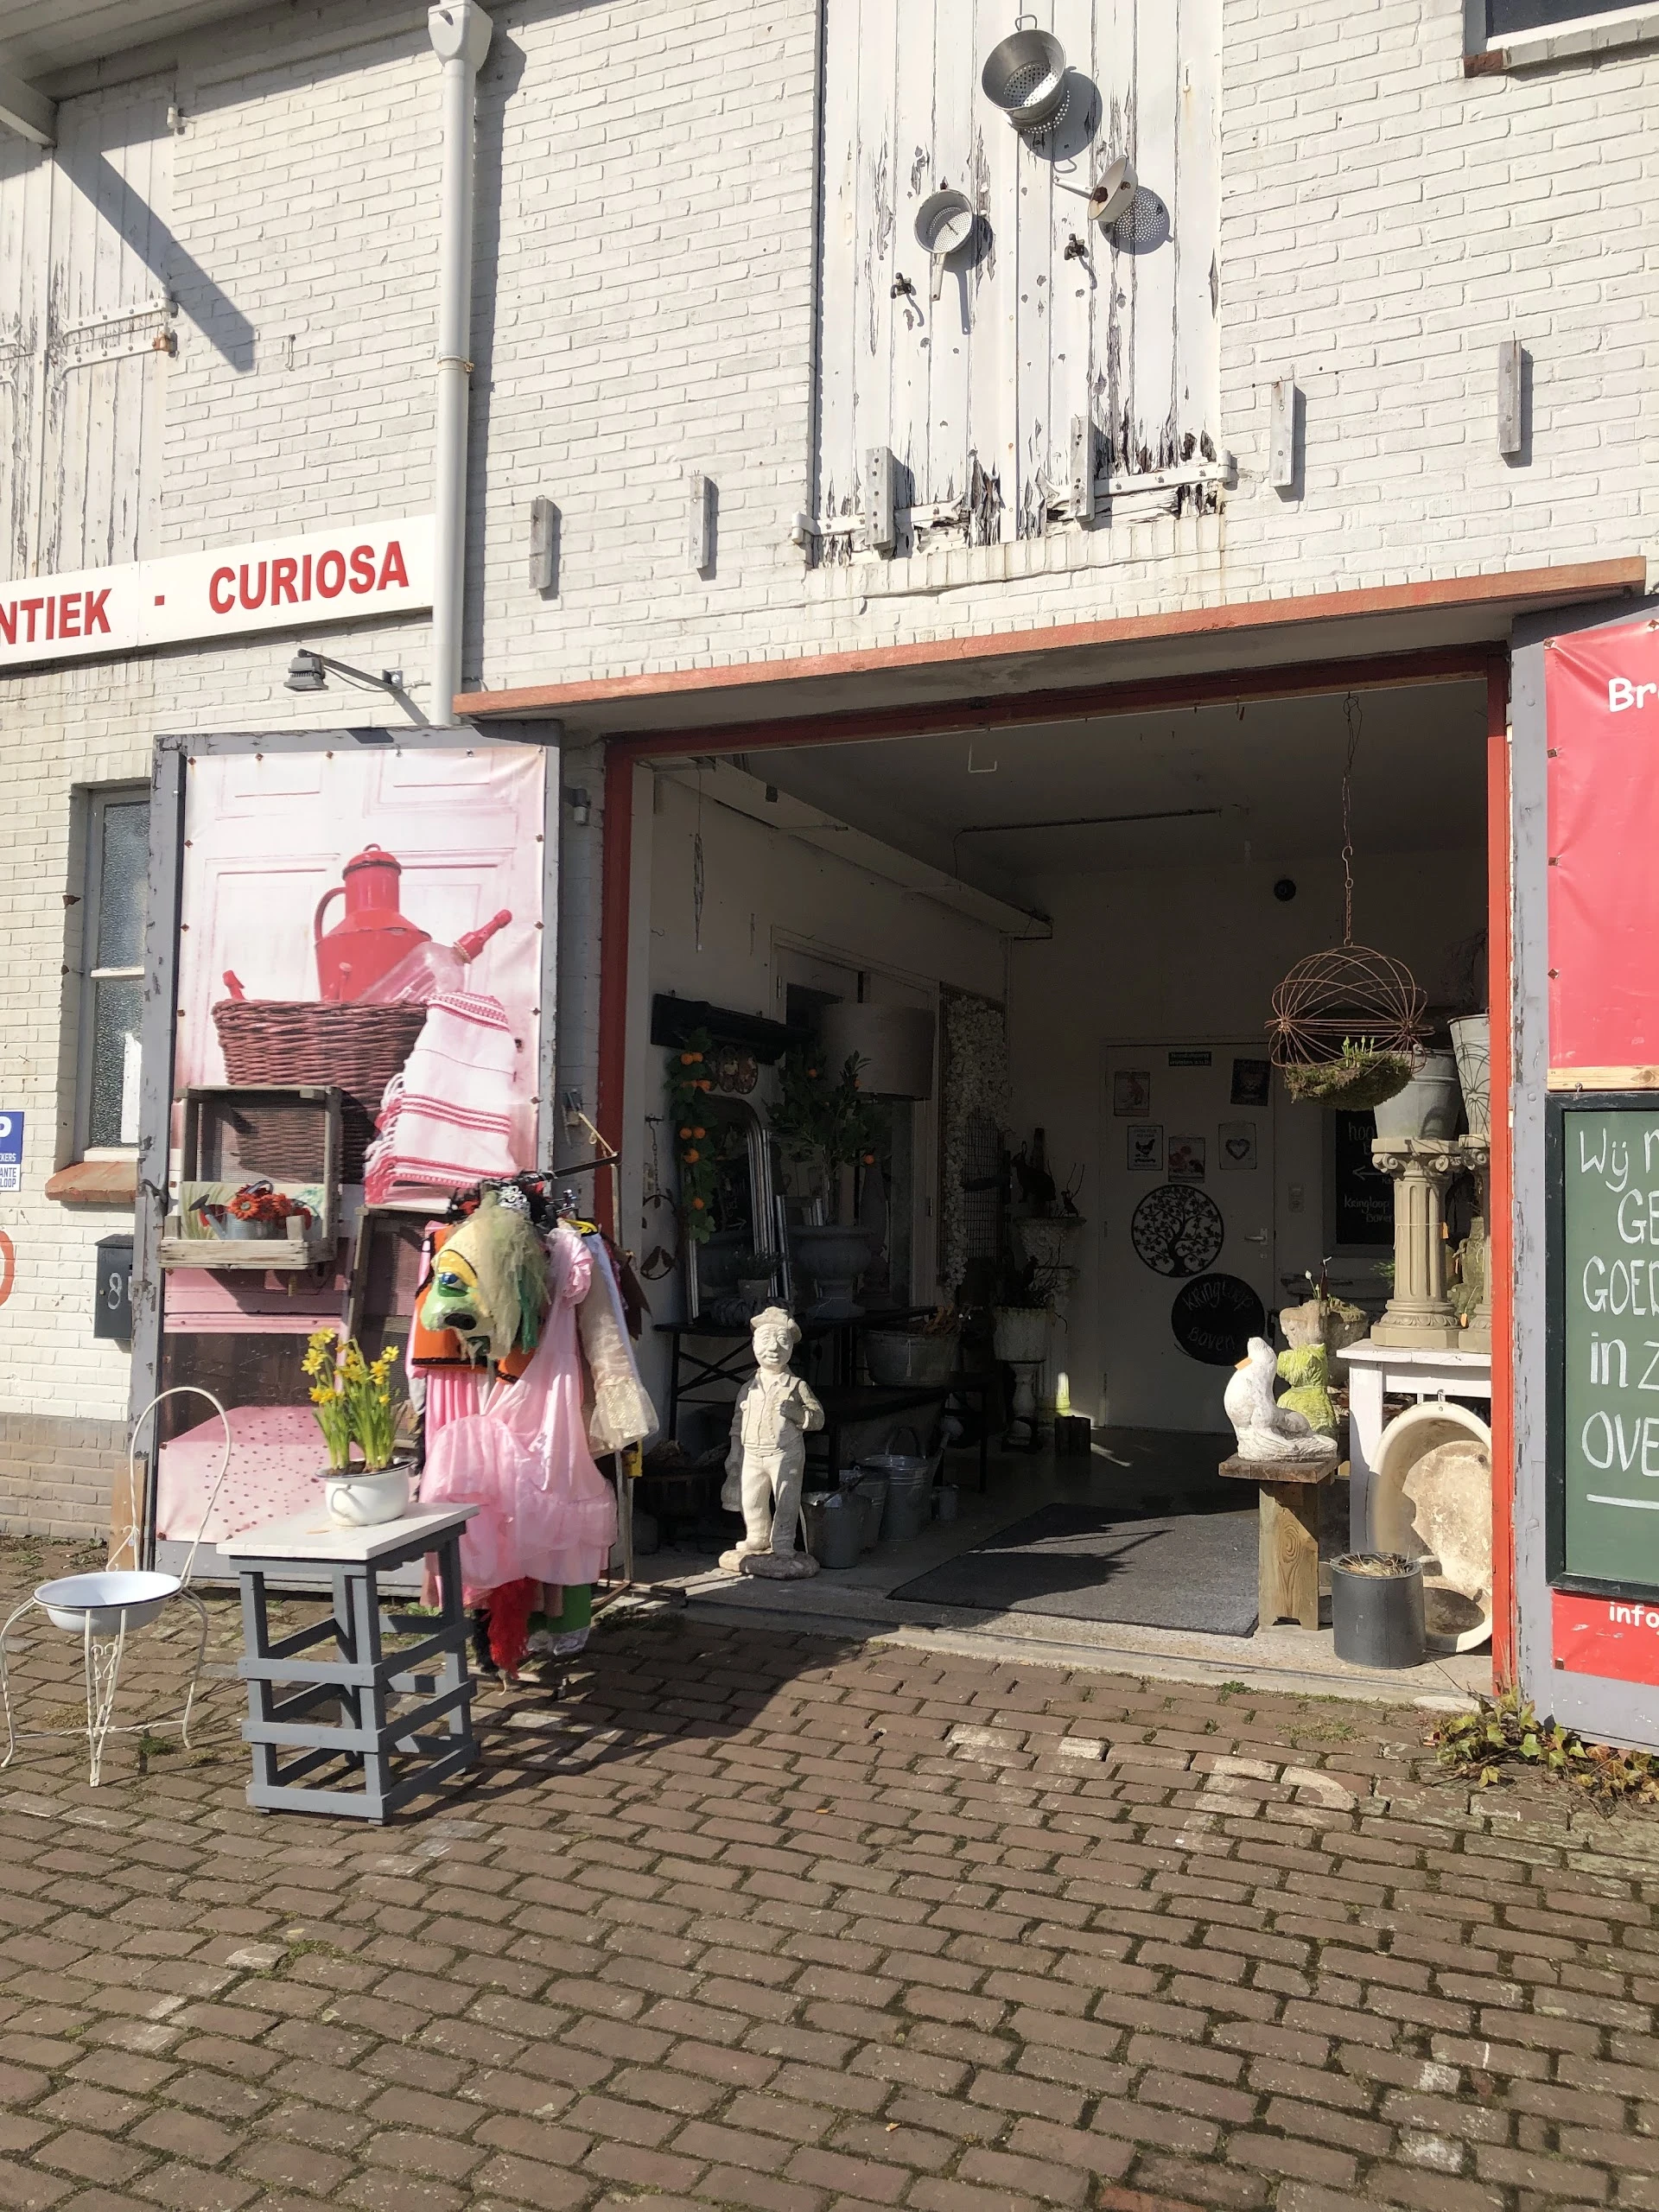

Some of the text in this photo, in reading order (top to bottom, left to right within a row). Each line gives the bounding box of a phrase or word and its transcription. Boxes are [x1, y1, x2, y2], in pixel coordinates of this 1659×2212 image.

[0, 588, 112, 645] NTIEK
[209, 541, 410, 613] CURIOSA
[1608, 677, 1659, 713] Br
[107, 1273, 123, 1310] 8
[1590, 1332, 1629, 1389] in
[1582, 1410, 1659, 1478] OVE
